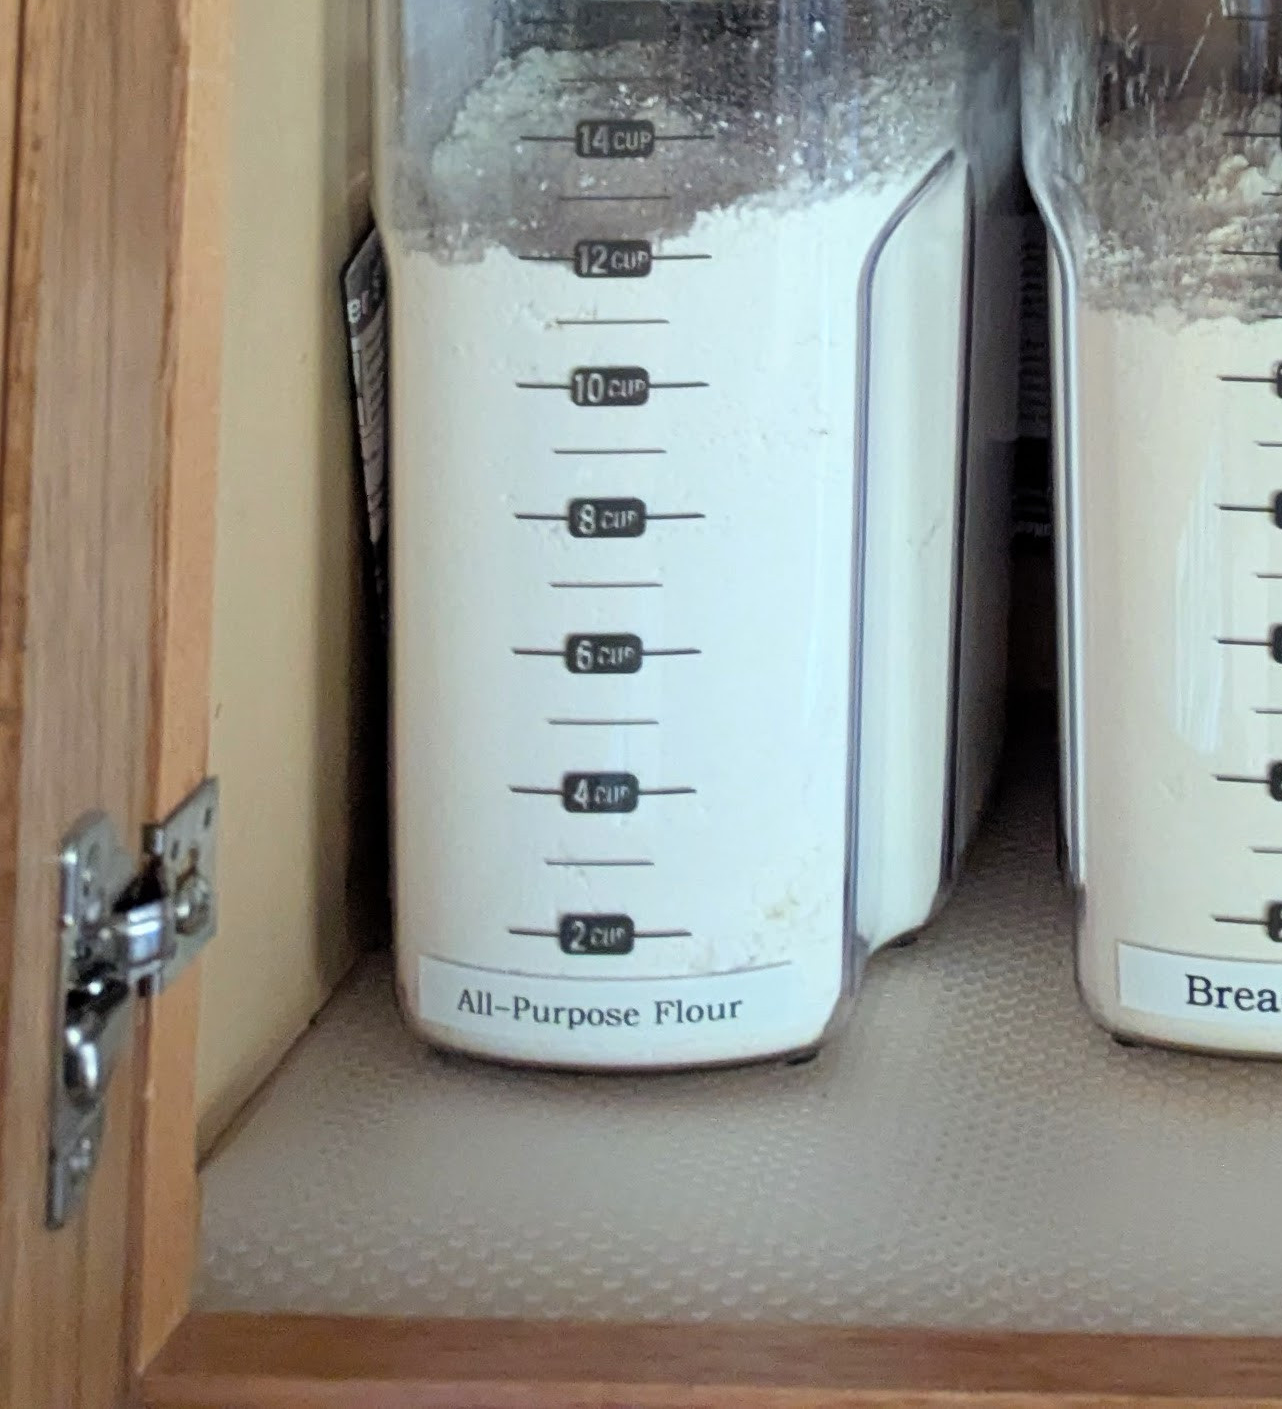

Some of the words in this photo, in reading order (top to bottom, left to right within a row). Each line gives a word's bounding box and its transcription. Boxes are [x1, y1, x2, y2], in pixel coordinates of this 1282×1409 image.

[579, 124, 608, 155] 14
[613, 130, 652, 151] CUP
[580, 245, 607, 275] 12
[610, 251, 650, 270] CUP
[575, 373, 602, 403] 10
[608, 378, 648, 398] CUP
[579, 504, 598, 535] 8
[601, 510, 639, 529] CUP
[576, 640, 594, 671] 6
[597, 646, 635, 665] CUP
[573, 779, 590, 810] 4
[595, 785, 631, 804] CUP
[570, 919, 587, 951] 2
[591, 926, 627, 947] CUP
[457, 989, 640, 1029] All-Purpose
[654, 998, 743, 1024] Flour
